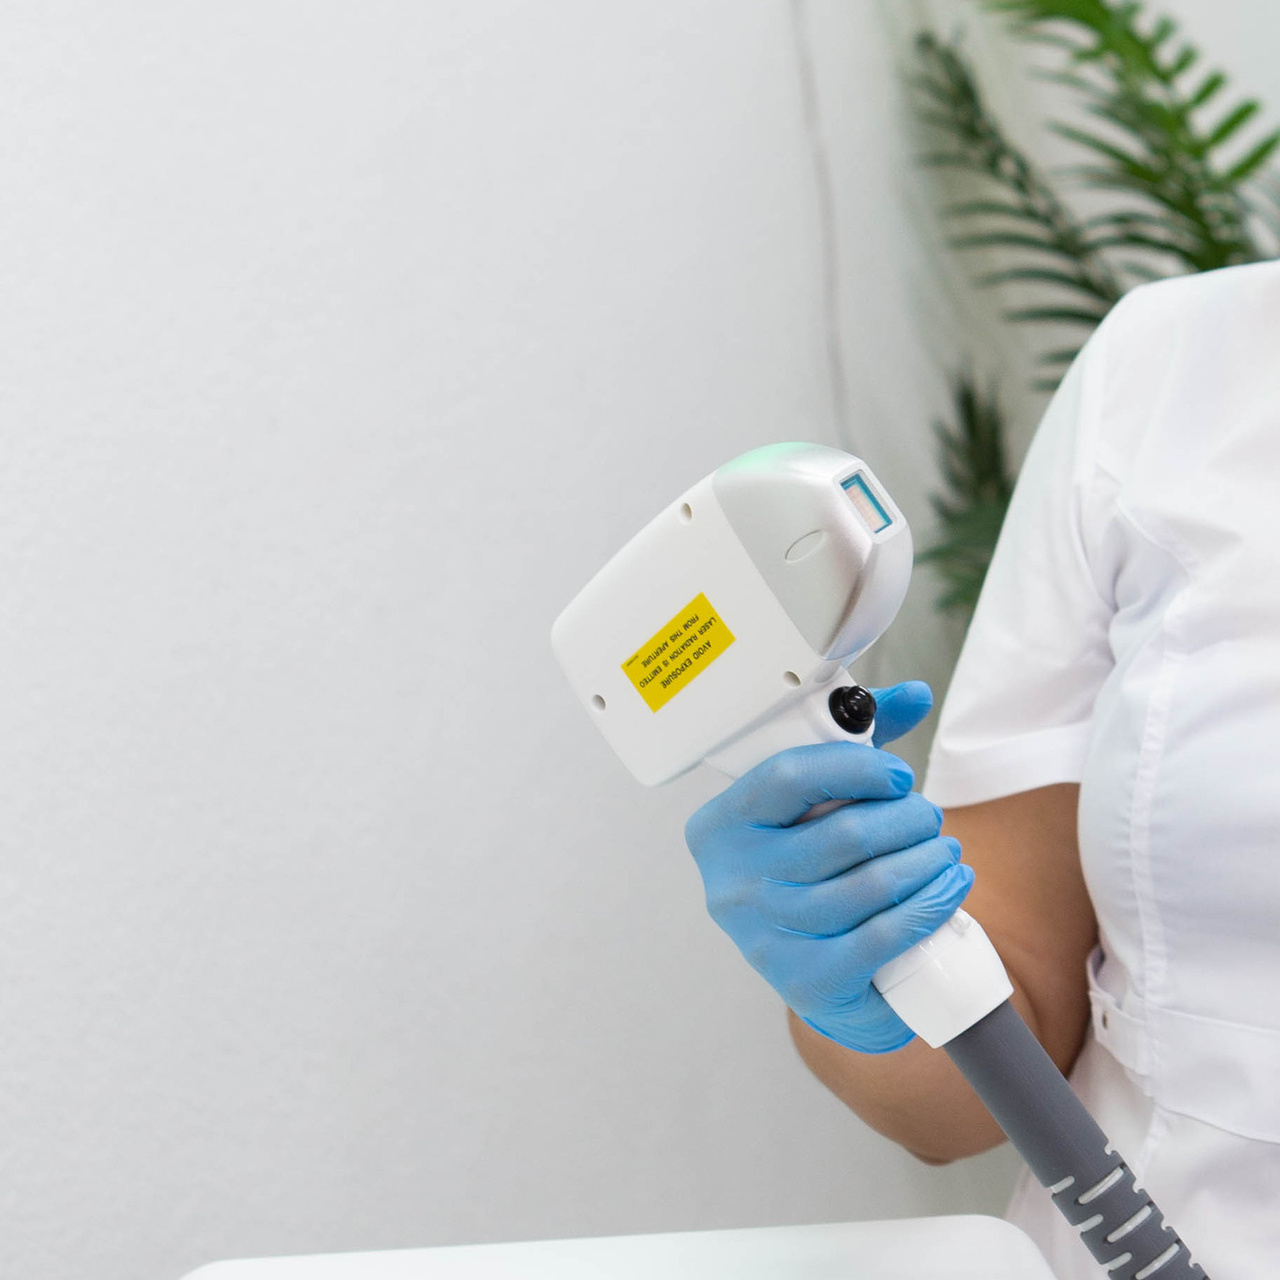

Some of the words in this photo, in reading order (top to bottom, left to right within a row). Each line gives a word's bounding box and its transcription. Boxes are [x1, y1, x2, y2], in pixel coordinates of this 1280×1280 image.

[682, 613, 700, 631] FROM
[698, 616, 717, 636] LASER
[669, 629, 683, 643] THIS
[641, 641, 669, 668] APERTURE
[669, 634, 698, 661] RADIATION
[692, 640, 712, 660] AVOID
[660, 657, 693, 689] EXPOSURE
[662, 659, 670, 668] IS
